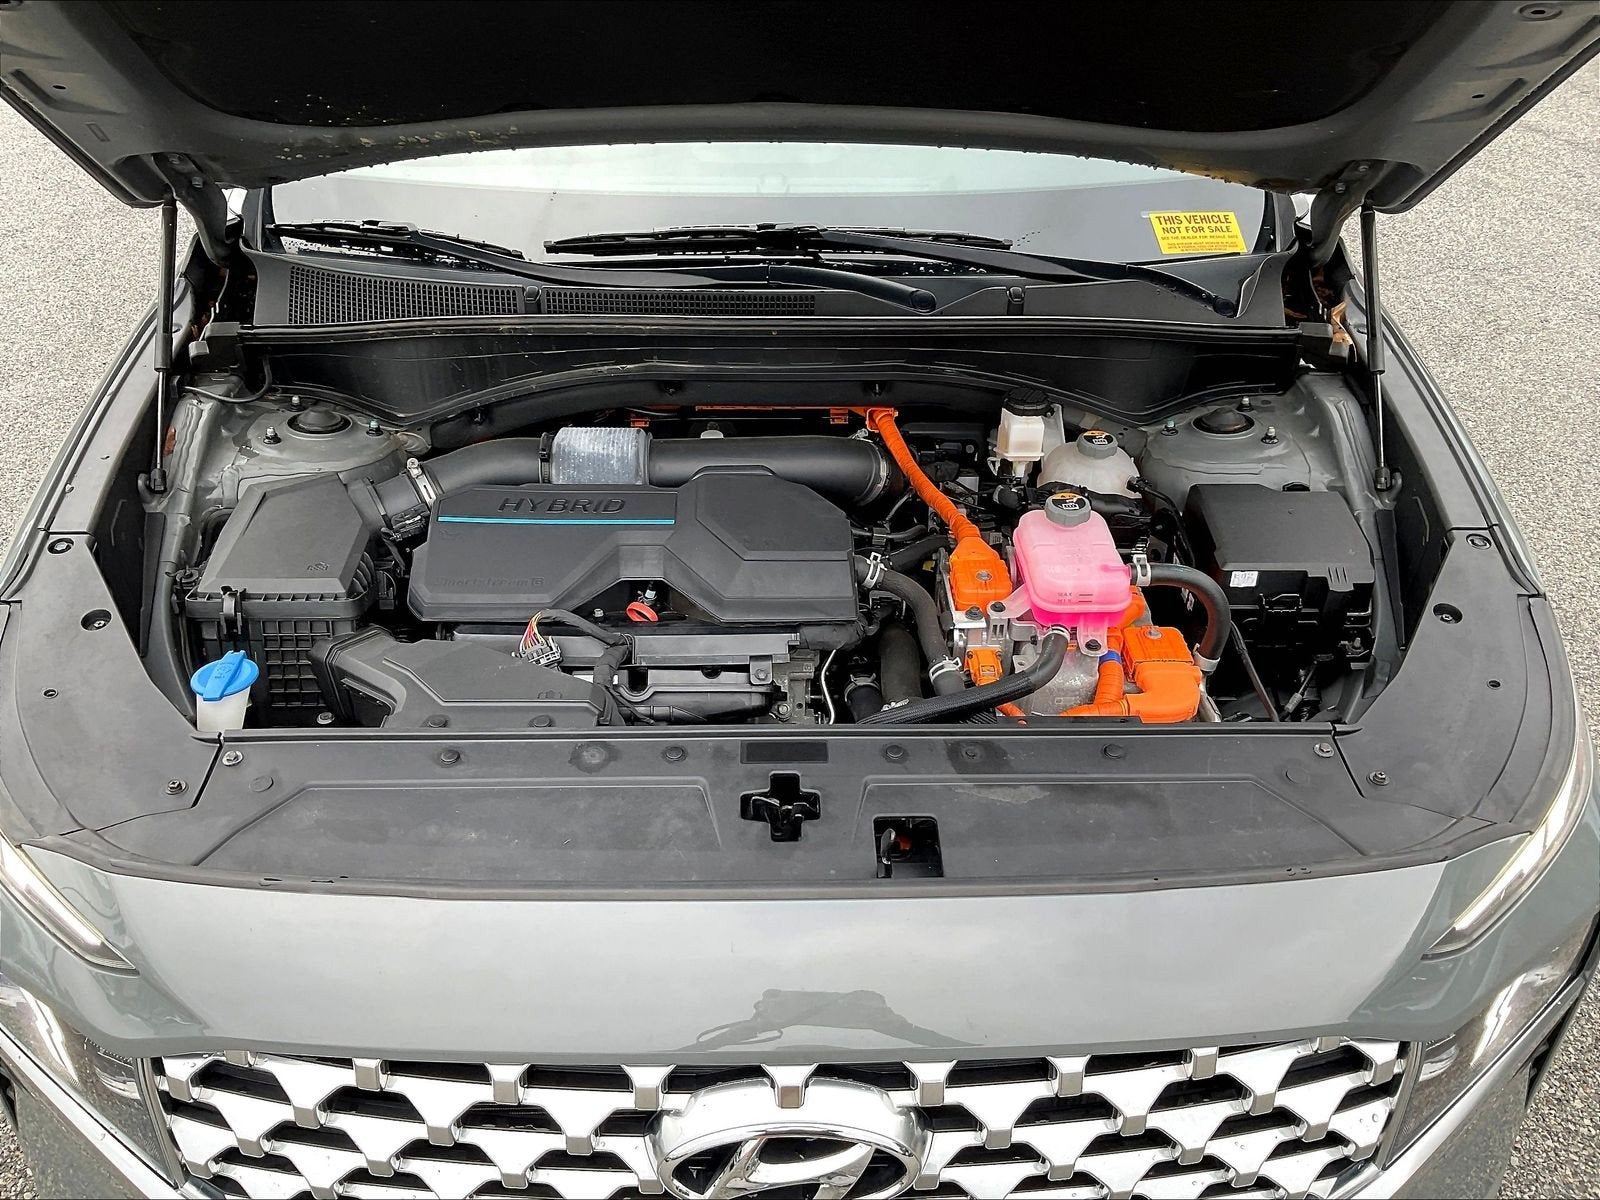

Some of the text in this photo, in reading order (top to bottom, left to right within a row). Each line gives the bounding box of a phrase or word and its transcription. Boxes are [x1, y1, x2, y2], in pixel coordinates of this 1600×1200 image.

[1155, 214, 1232, 226] THIS VEHICLE
[1162, 225, 1232, 235] NOT FOR SALE
[497, 497, 626, 514] HYBRID
